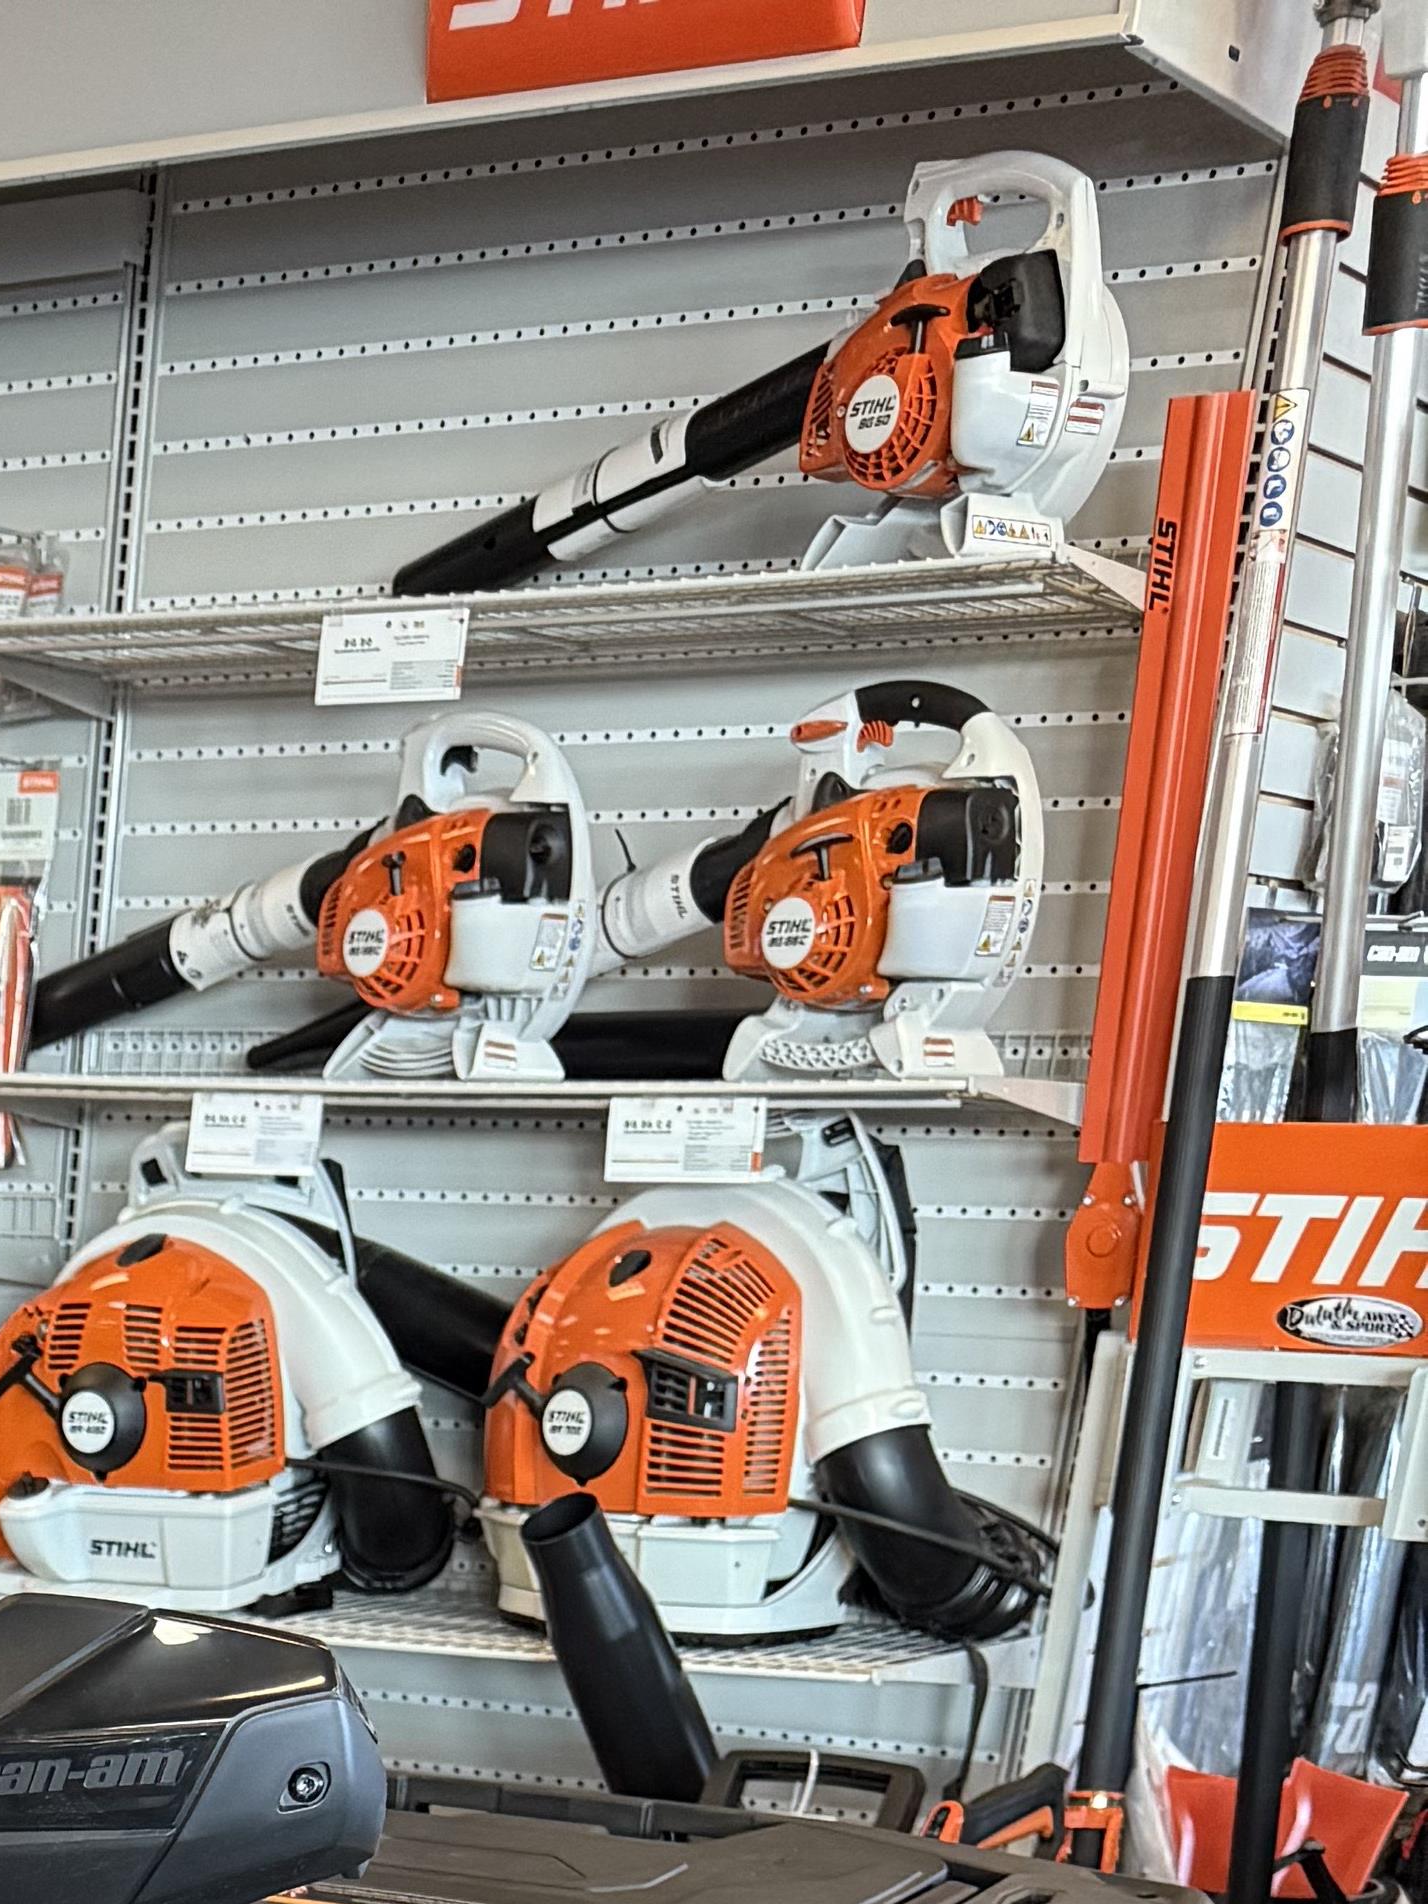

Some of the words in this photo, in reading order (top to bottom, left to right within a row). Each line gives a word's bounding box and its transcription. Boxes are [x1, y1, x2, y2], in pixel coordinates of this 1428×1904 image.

[849, 395, 896, 418] STIHL
[1149, 517, 1177, 611] STIHL
[670, 874, 689, 920] STIHL
[766, 918, 812, 935] STIHL
[1193, 1192, 1428, 1289] STIH
[89, 1540, 156, 1560] STIHL
